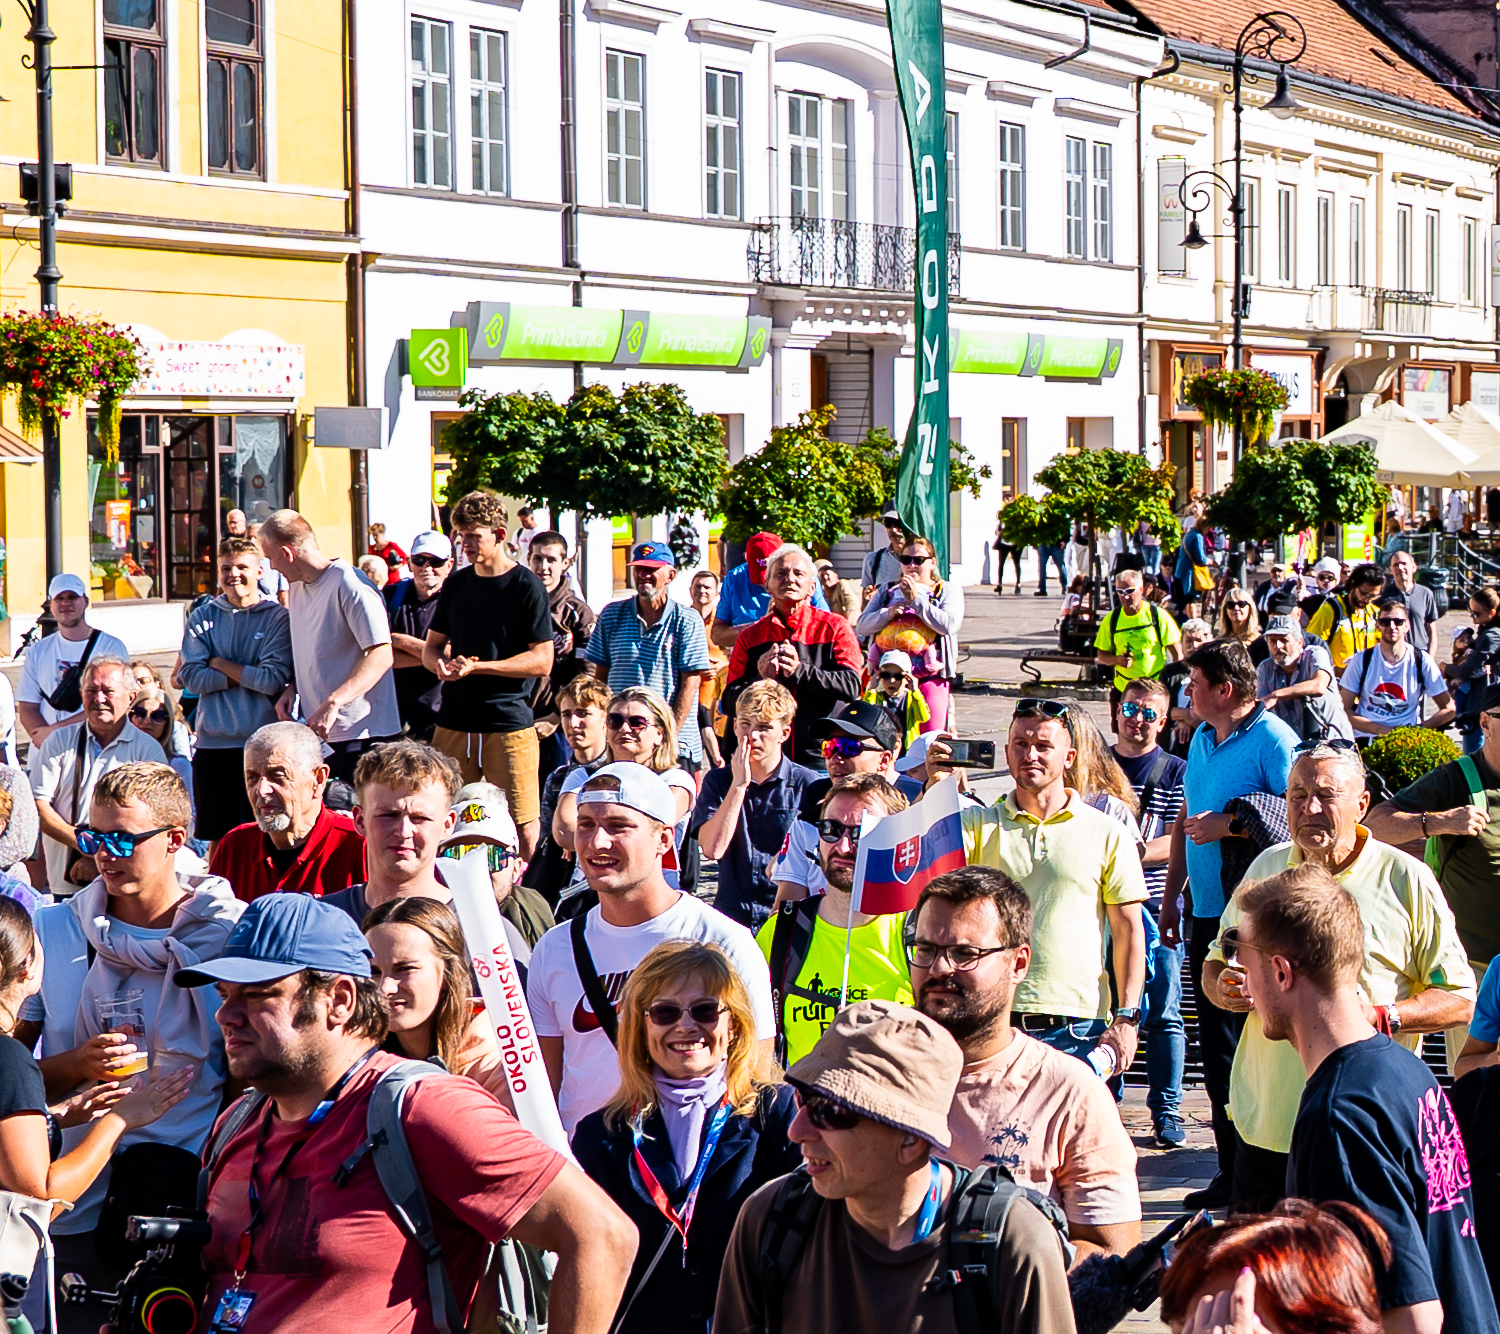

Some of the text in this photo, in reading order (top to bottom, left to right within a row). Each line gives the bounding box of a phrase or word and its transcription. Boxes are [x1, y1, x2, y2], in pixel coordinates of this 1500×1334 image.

[165, 357, 200, 373] Sweet
[417, 389, 458, 398] BANKOMAT
[491, 942, 539, 1064] SLOVENSKA
[496, 1024, 528, 1094] OKOLO
